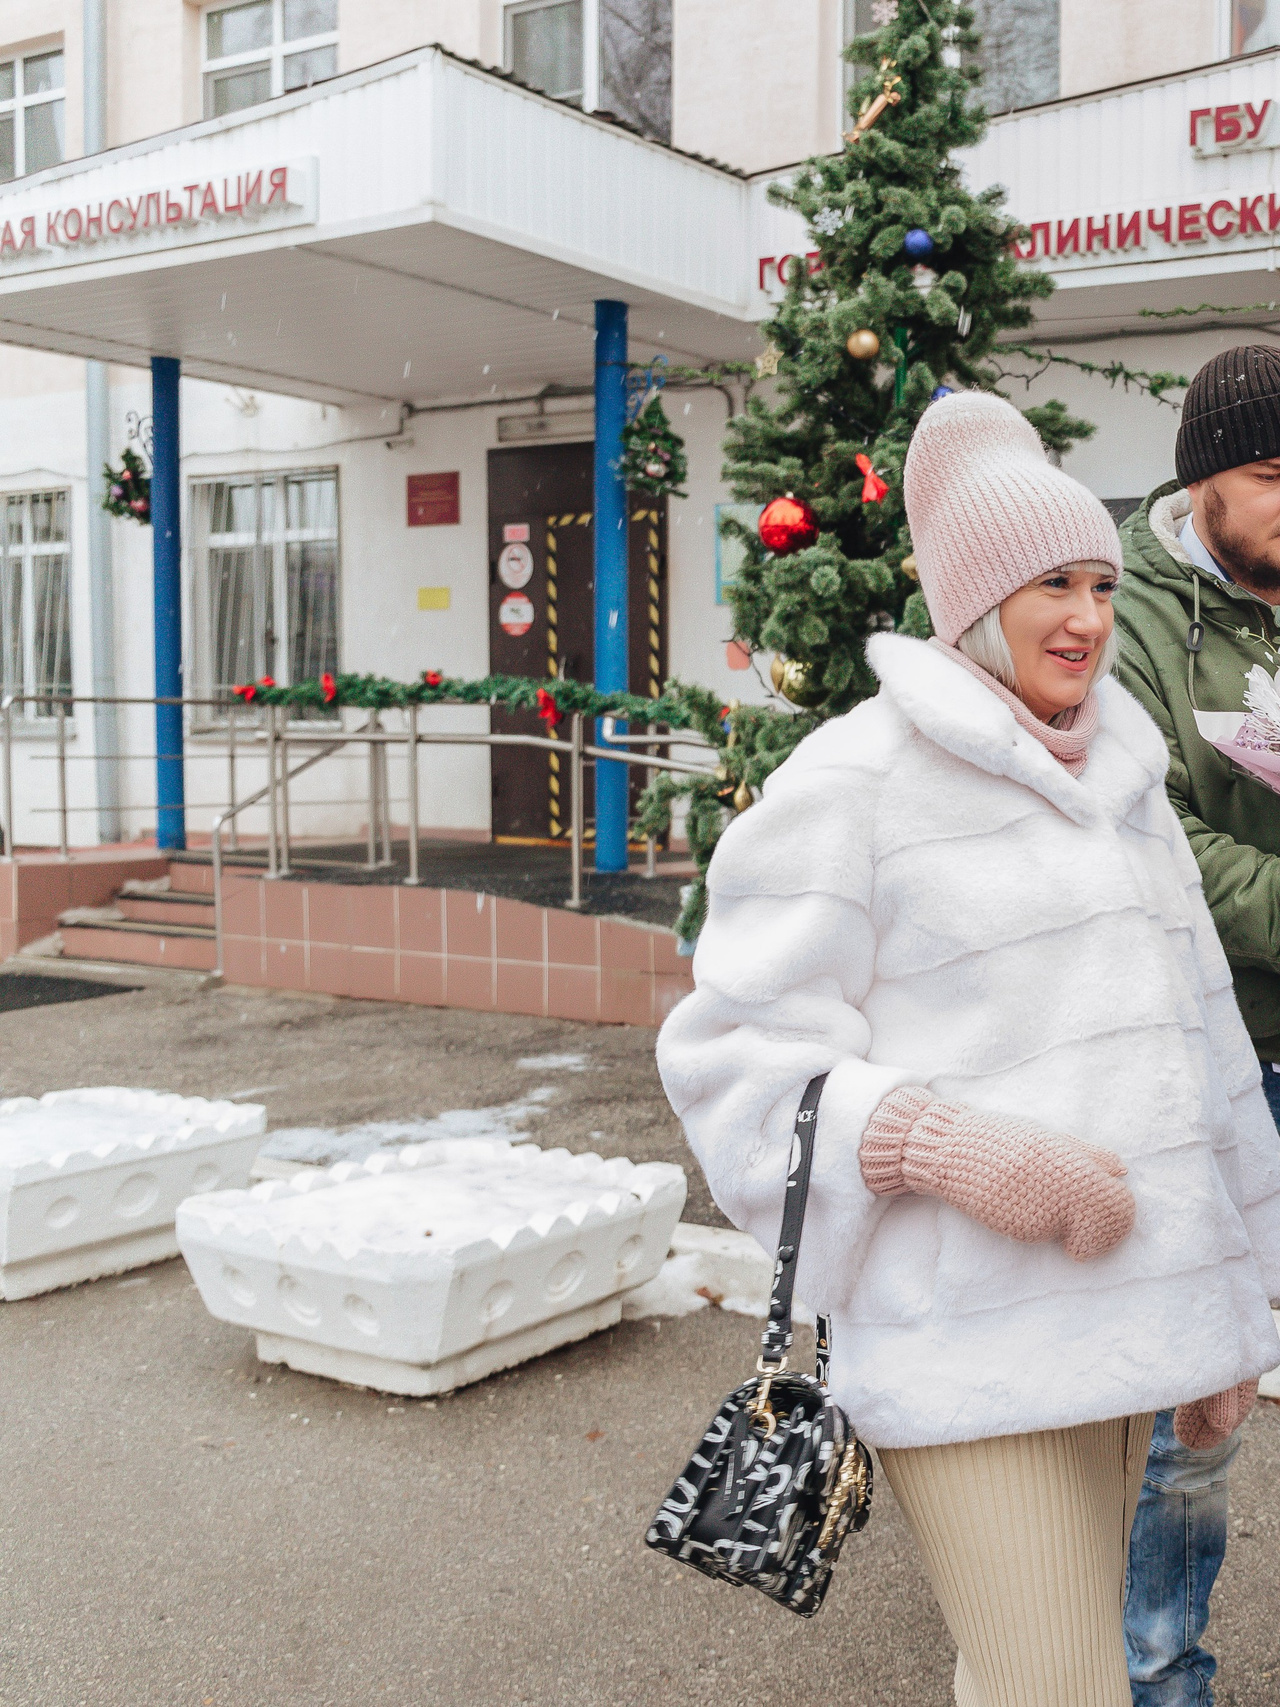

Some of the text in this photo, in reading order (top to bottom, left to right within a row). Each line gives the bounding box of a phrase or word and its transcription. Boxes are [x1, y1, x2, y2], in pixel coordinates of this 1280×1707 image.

[1190, 99, 1272, 146] ГБУ
[0, 166, 289, 252] АЯ КОНСУЛЬТАЦИЯ
